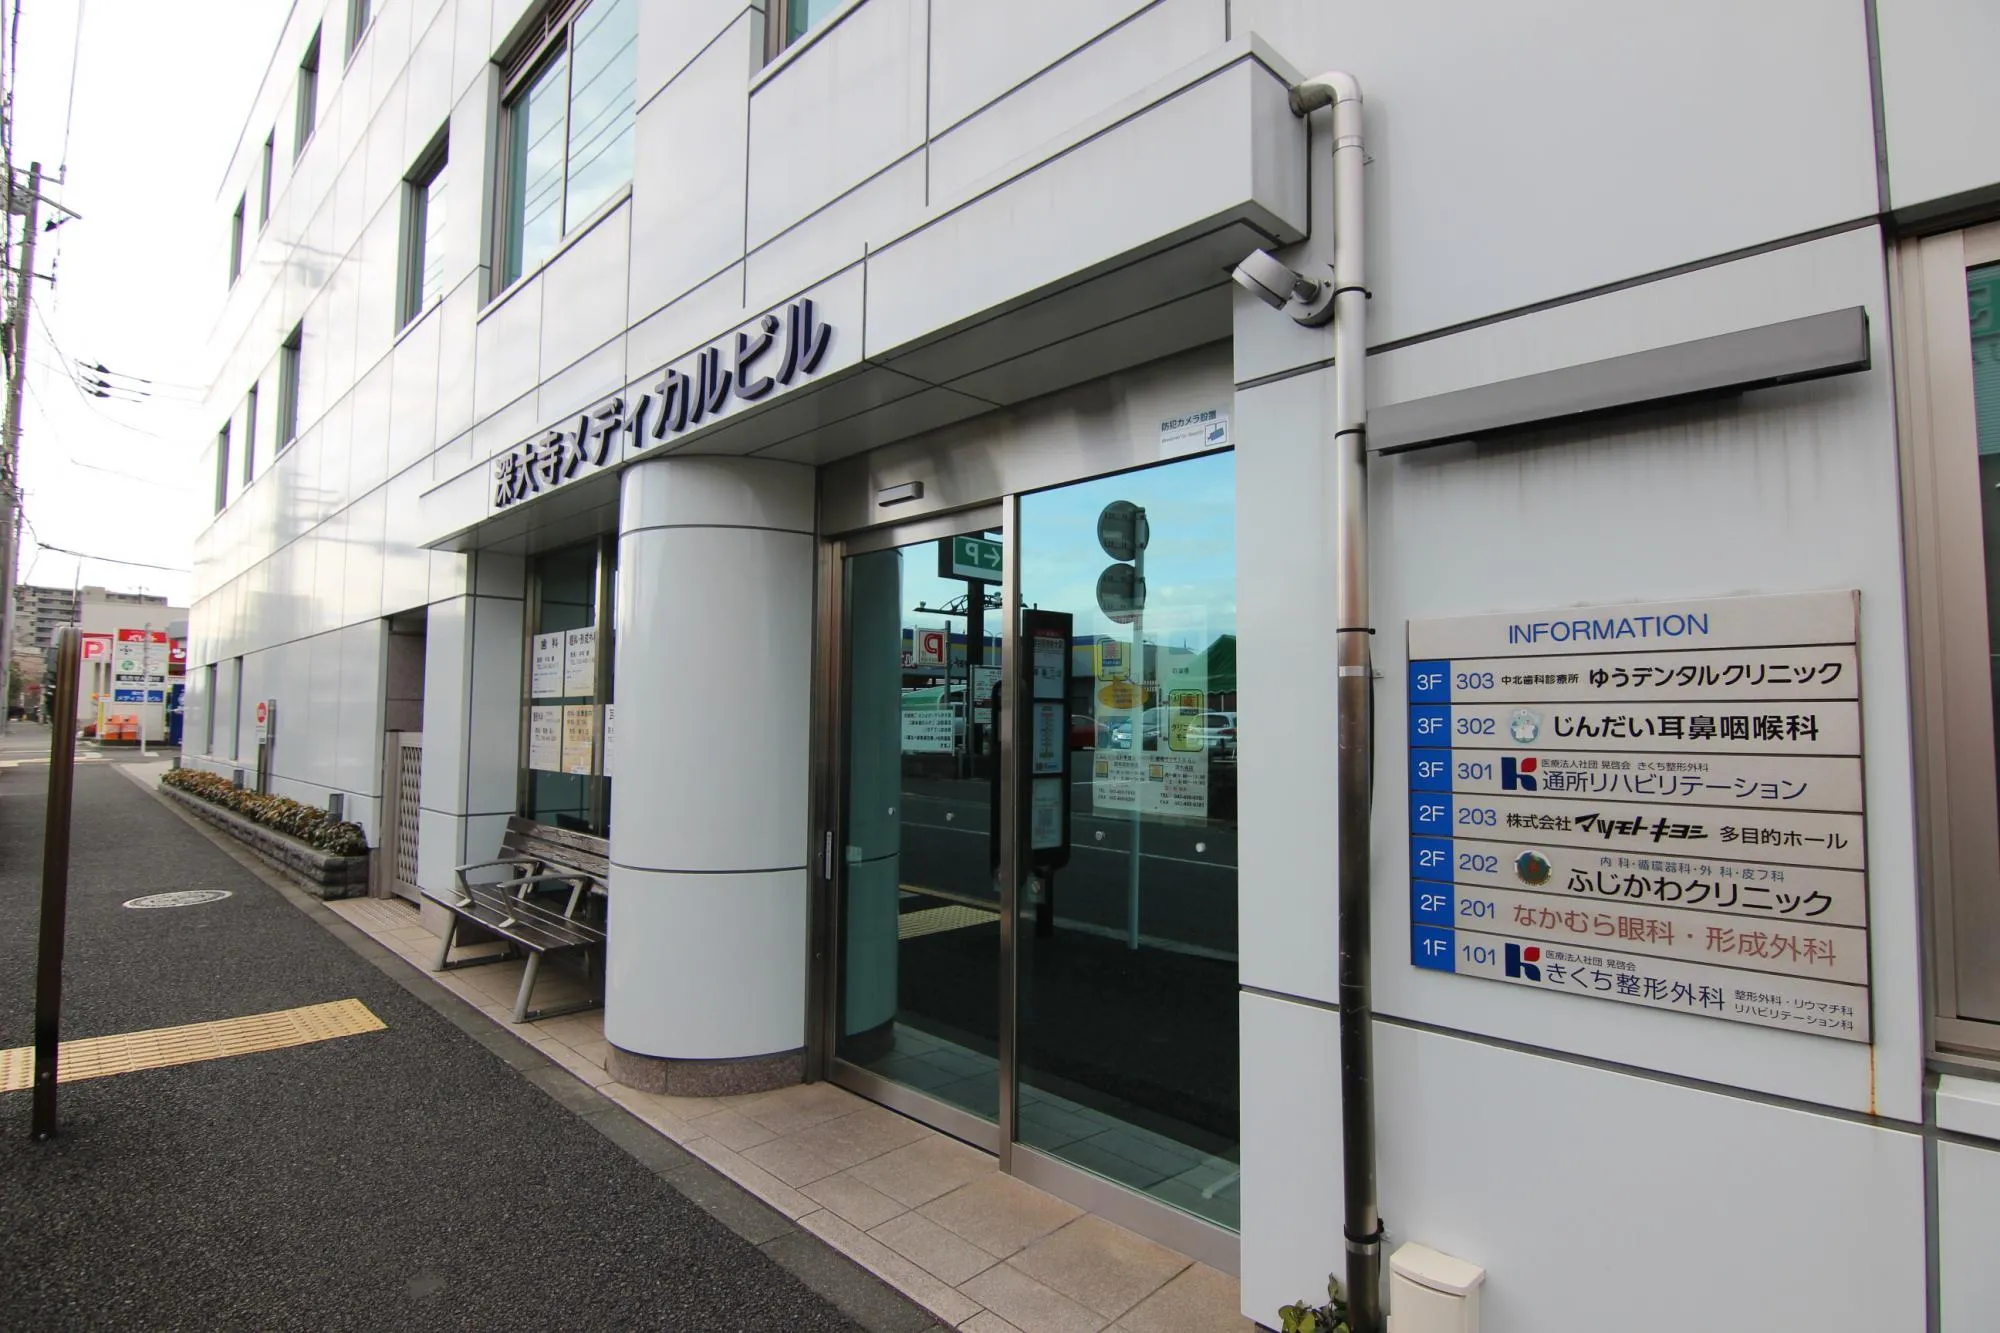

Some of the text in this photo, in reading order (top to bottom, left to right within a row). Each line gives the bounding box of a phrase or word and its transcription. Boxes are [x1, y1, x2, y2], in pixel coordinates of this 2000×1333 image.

[495, 298, 831, 507] 深大寺メディカルビル
[1161, 410, 1217, 432] 防犯カメラ設置
[1509, 614, 1709, 644] INFORMATION
[84, 641, 104, 659] P
[1417, 663, 1842, 690] 3F 303 中北歯科診療所 ゆうデンタルクリニック
[1417, 715, 1819, 741] 3F 302 じんだい耳鼻咽喉科
[1418, 761, 1493, 780] 3F 301
[1541, 759, 1598, 769] 医療法人社団
[1637, 762, 1709, 772] きくち整形外科
[1542, 770, 1808, 800] 通所リハビリテーション
[1419, 805, 1848, 850] 2F 203 株式会社 マツモトキヨシ 多目的ホール
[1419, 850, 1498, 873] 2F 202
[1567, 868, 1832, 917] ふじかわクリニック
[1420, 894, 1836, 967] 2F 201 なかむら眼科・形成外科
[1423, 939, 1496, 966] 1F 101
[1545, 950, 1602, 966] 医療法人社団
[1546, 963, 1725, 1011] きくち整形外科
[1735, 989, 1853, 1017] 整形外科・リウマチ科
[1735, 1003, 1853, 1031] リハビリテーション科
